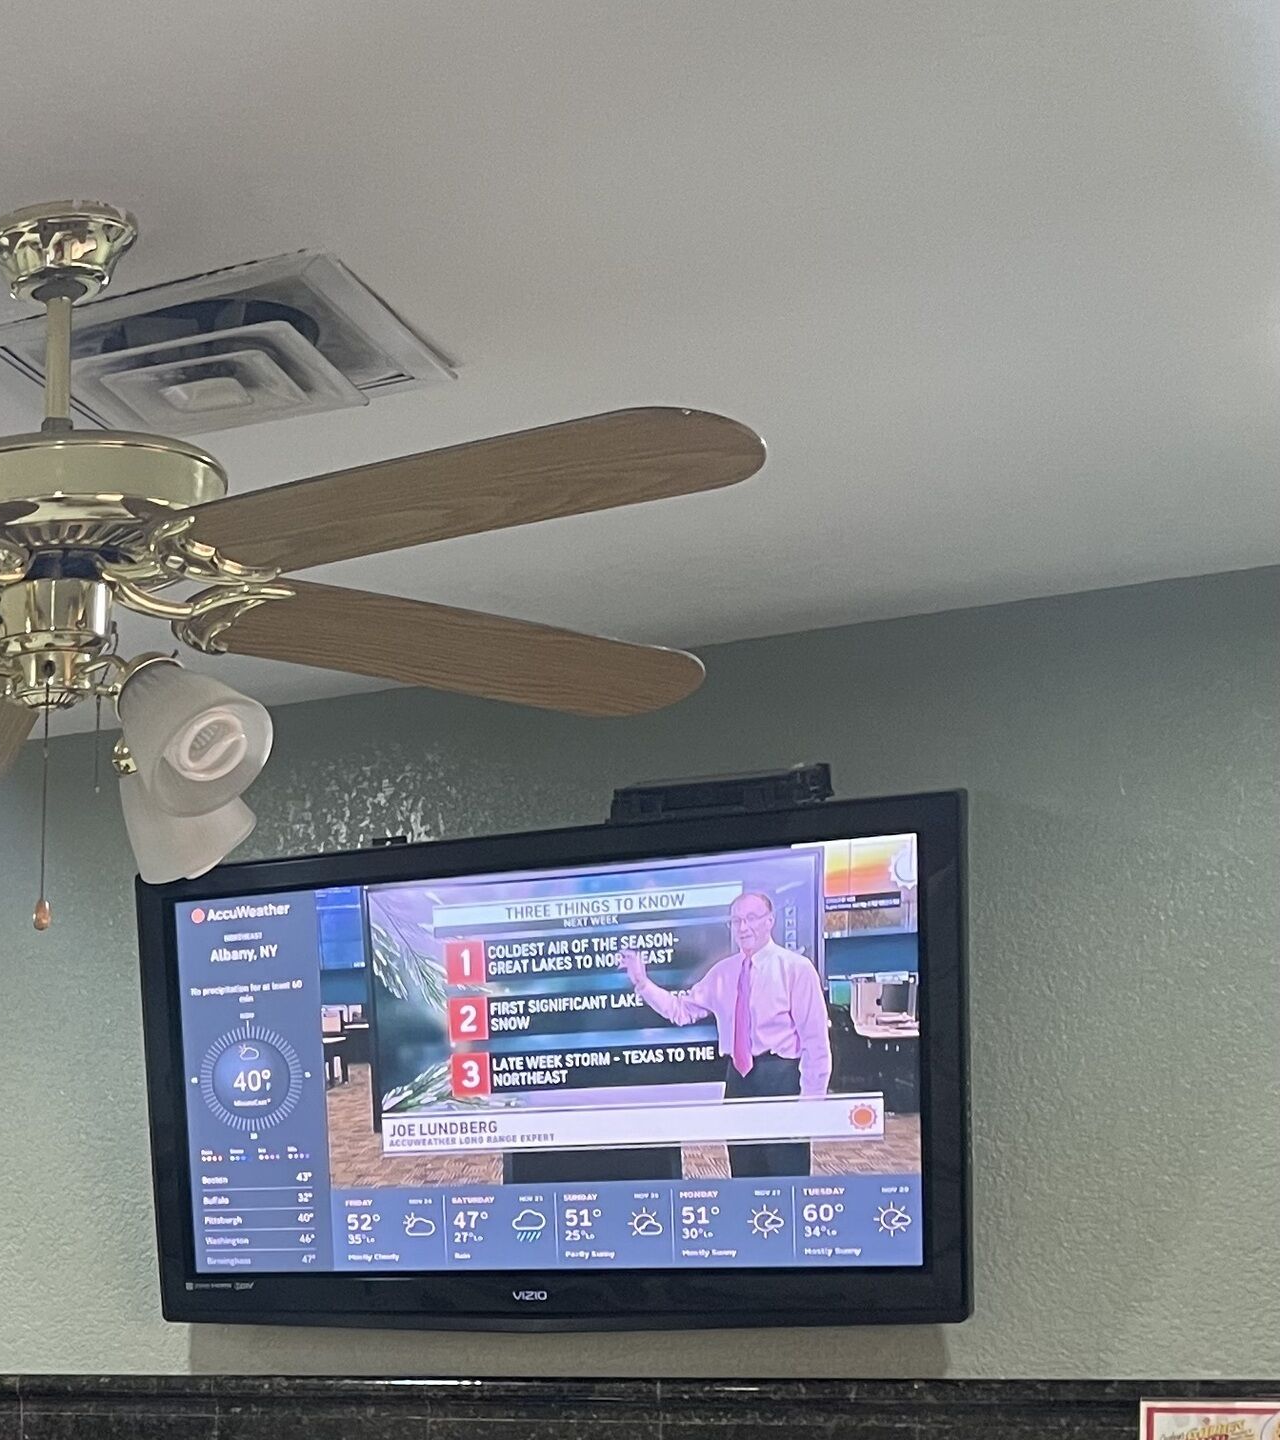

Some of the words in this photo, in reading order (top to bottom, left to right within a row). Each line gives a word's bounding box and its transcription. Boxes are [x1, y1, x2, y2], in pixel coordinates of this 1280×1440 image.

[207, 903, 290, 921] AccuWeather
[505, 904, 551, 920] THREE
[556, 900, 611, 916] THINGS
[615, 897, 634, 912] TO
[638, 893, 686, 909] KNOW
[563, 917, 589, 928] NEXT
[591, 914, 619, 926] WEEK
[210, 949, 257, 962] Albany,
[260, 944, 278, 958] NY
[488, 941, 545, 959] COLDEST
[547, 939, 570, 955] AIR
[572, 937, 589, 953] OF
[592, 936, 618, 952] THE
[621, 932, 679, 949] SEASON-
[460, 949, 471, 976] 1
[488, 958, 529, 975] GREAT
[532, 956, 573, 972] LAKES
[576, 954, 592, 969] TO
[203, 984, 249, 996] precipitation
[250, 983, 261, 992] for
[262, 983, 271, 991] at
[292, 979, 302, 989] 60
[490, 1001, 525, 1016] FIRST
[528, 995, 608, 1014] SIGNIFICANT
[611, 991, 644, 1008] LAKE
[459, 1005, 477, 1032] 2
[491, 1016, 530, 1031] SNOW
[492, 1056, 523, 1072] LATE
[526, 1054, 562, 1070] WEEK
[565, 1051, 610, 1068] STORM
[623, 1048, 664, 1065] TEXAS
[667, 1047, 684, 1062] TO
[687, 1045, 715, 1061] THE
[462, 1060, 480, 1088] 3
[493, 1070, 568, 1087] NORTHEAST
[390, 1124, 416, 1137] JOE
[419, 1121, 498, 1136] LUNDBERG
[390, 1136, 456, 1147] ACCUWEATHER
[459, 1135, 483, 1144] LONG
[487, 1134, 517, 1143] RANGE
[521, 1133, 554, 1142] EXPERT
[451, 1196, 495, 1204] SATURDAY
[563, 1193, 598, 1201] SUNDAY
[679, 1190, 719, 1199] MONDAY
[803, 1187, 845, 1196] TUESDAY
[203, 1196, 229, 1205] Buffalo
[345, 1199, 373, 1207] FRIDAY
[204, 1216, 242, 1225] Pittsburgh
[453, 1210, 489, 1229] 47°
[565, 1208, 601, 1227] 51°
[681, 1206, 719, 1225] 51°
[803, 1203, 844, 1222] 60°
[346, 1213, 381, 1231] 52°
[205, 1237, 249, 1246] Washington
[804, 1248, 833, 1257] Mostly
[512, 1290, 548, 1301] VIZIO
